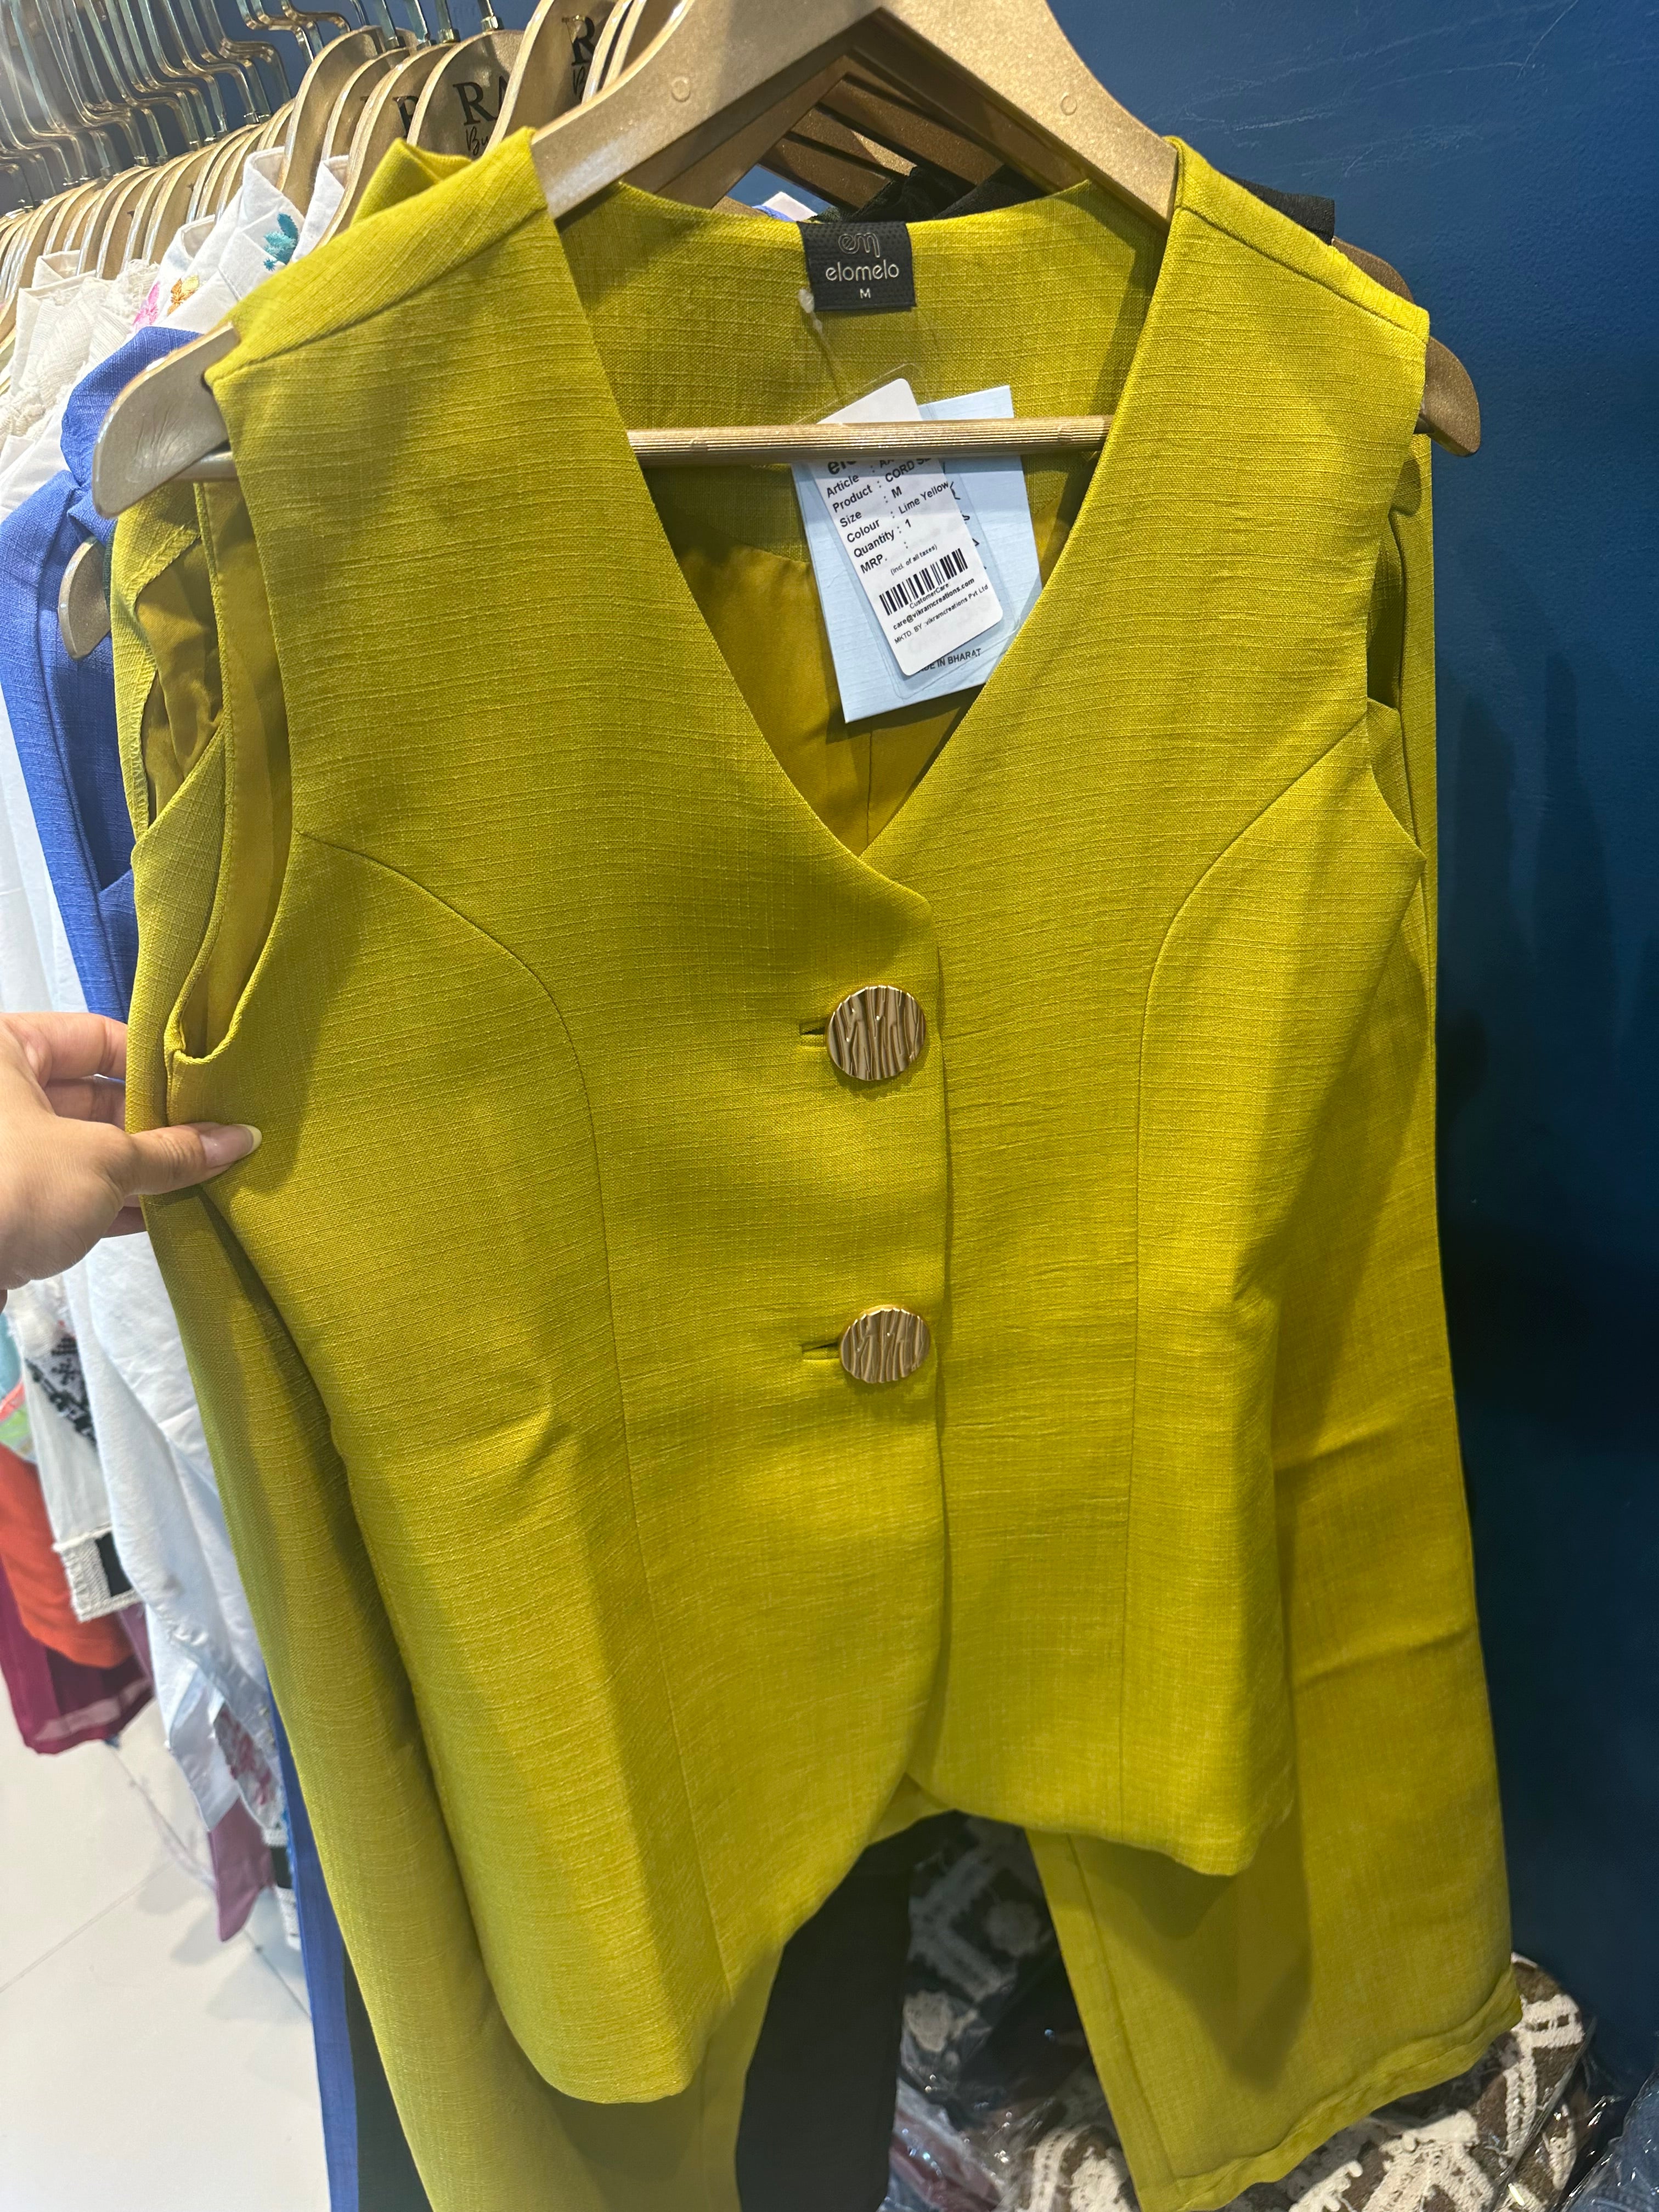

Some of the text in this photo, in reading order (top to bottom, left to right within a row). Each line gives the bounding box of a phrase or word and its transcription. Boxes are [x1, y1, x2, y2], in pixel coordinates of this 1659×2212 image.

[825, 259, 900, 282] elomelo
[860, 287, 871, 299] M
[827, 474, 860, 498] Article
[832, 484, 873, 513] Product
[885, 460, 915, 483] CORD
[839, 511, 862, 528] Size
[891, 486, 902, 499] M
[847, 520, 880, 543] Colour
[898, 498, 921, 514] Lime
[921, 481, 950, 501] Yellow
[854, 529, 894, 558] Quantity
[905, 518, 911, 528] 1
[893, 578, 974, 630] care@vikramcreations.com
[968, 590, 978, 599] Pvt
[978, 584, 989, 594] Ltd
[937, 658, 946, 668] IN
[947, 648, 981, 665] BHARAT
